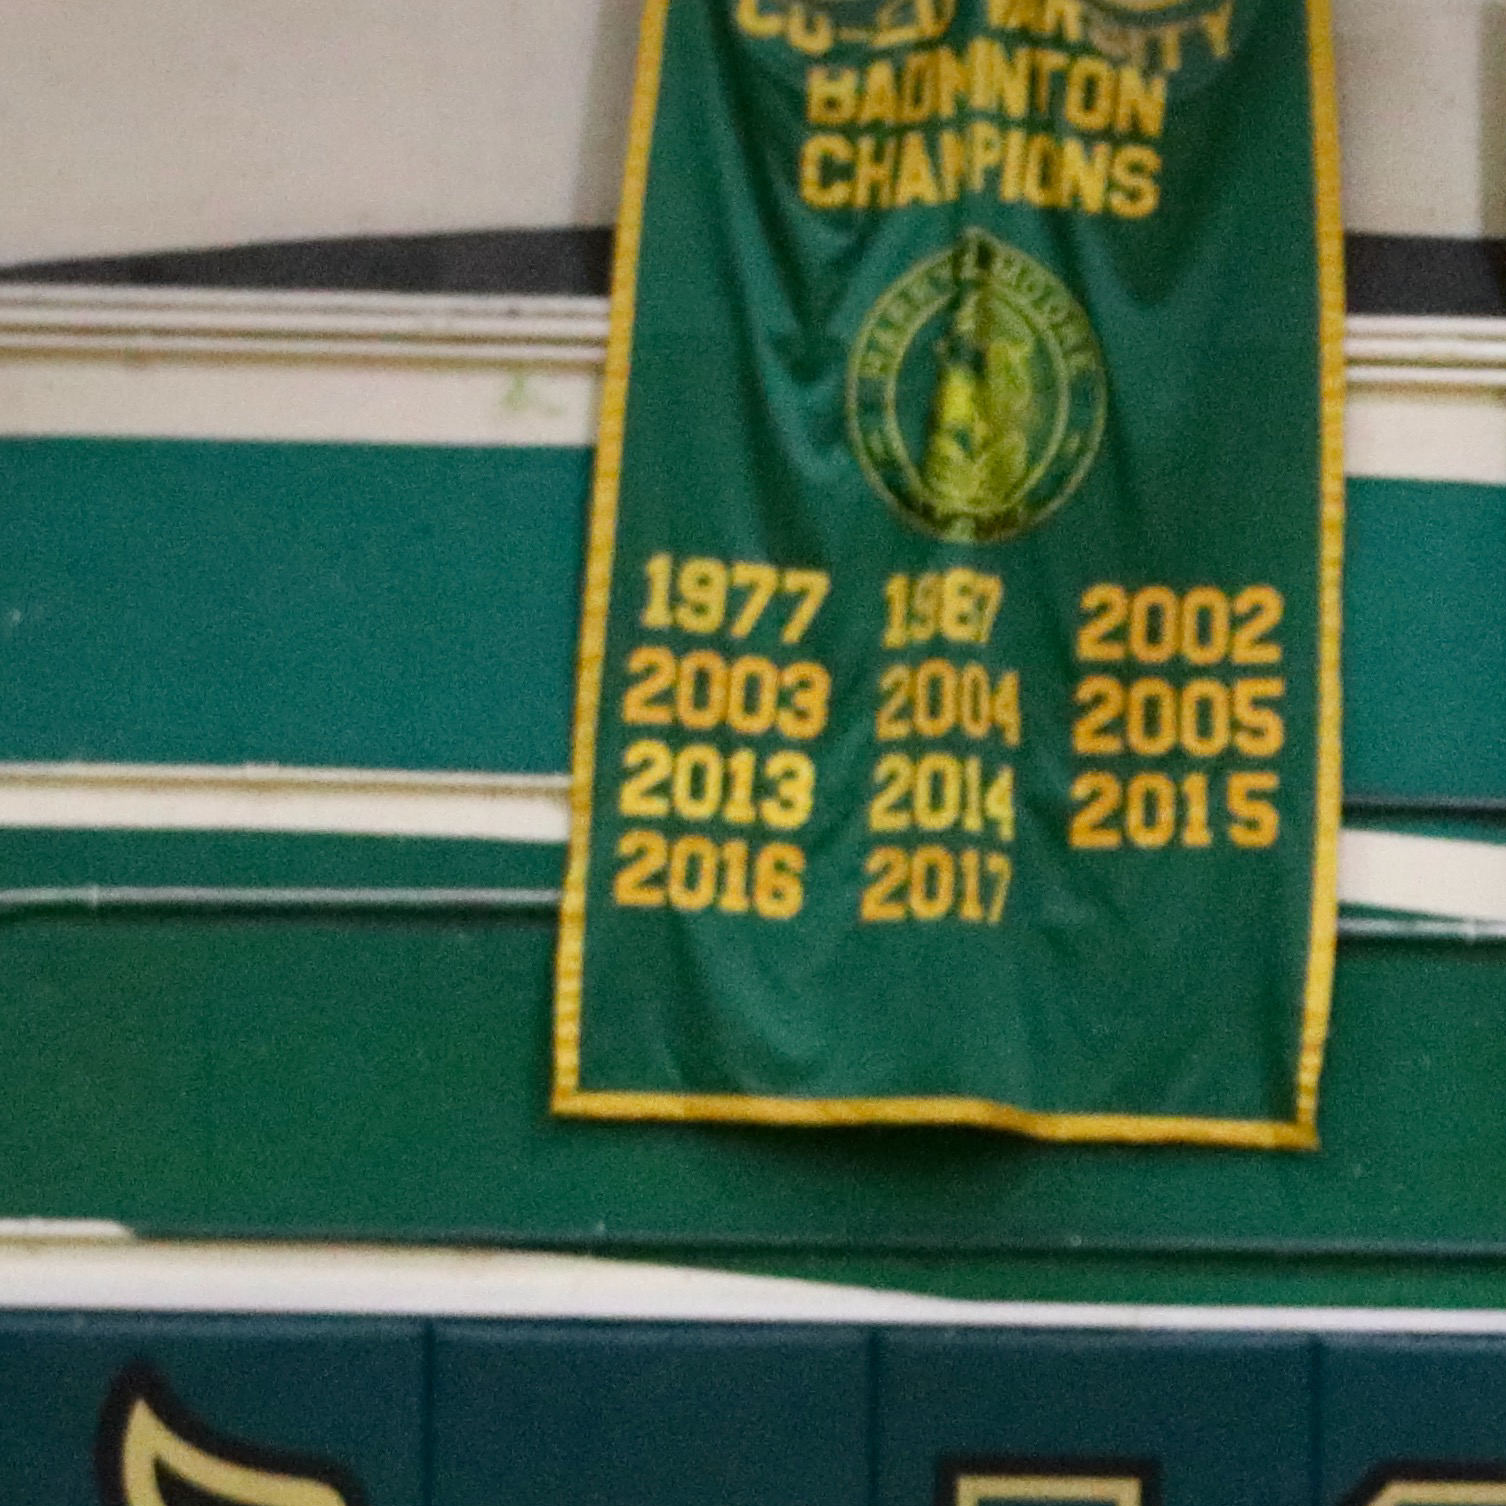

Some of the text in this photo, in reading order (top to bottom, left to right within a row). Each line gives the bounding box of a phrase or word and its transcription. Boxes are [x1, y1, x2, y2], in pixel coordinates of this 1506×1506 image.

[802, 123, 1162, 218] CHAMPIONS
[642, 553, 1284, 666] 1977 1987 2002
[622, 646, 1285, 758] 2003 2004 2005
[619, 739, 1280, 849] 2013 2014 2015
[613, 829, 1012, 922] 2016 2017
